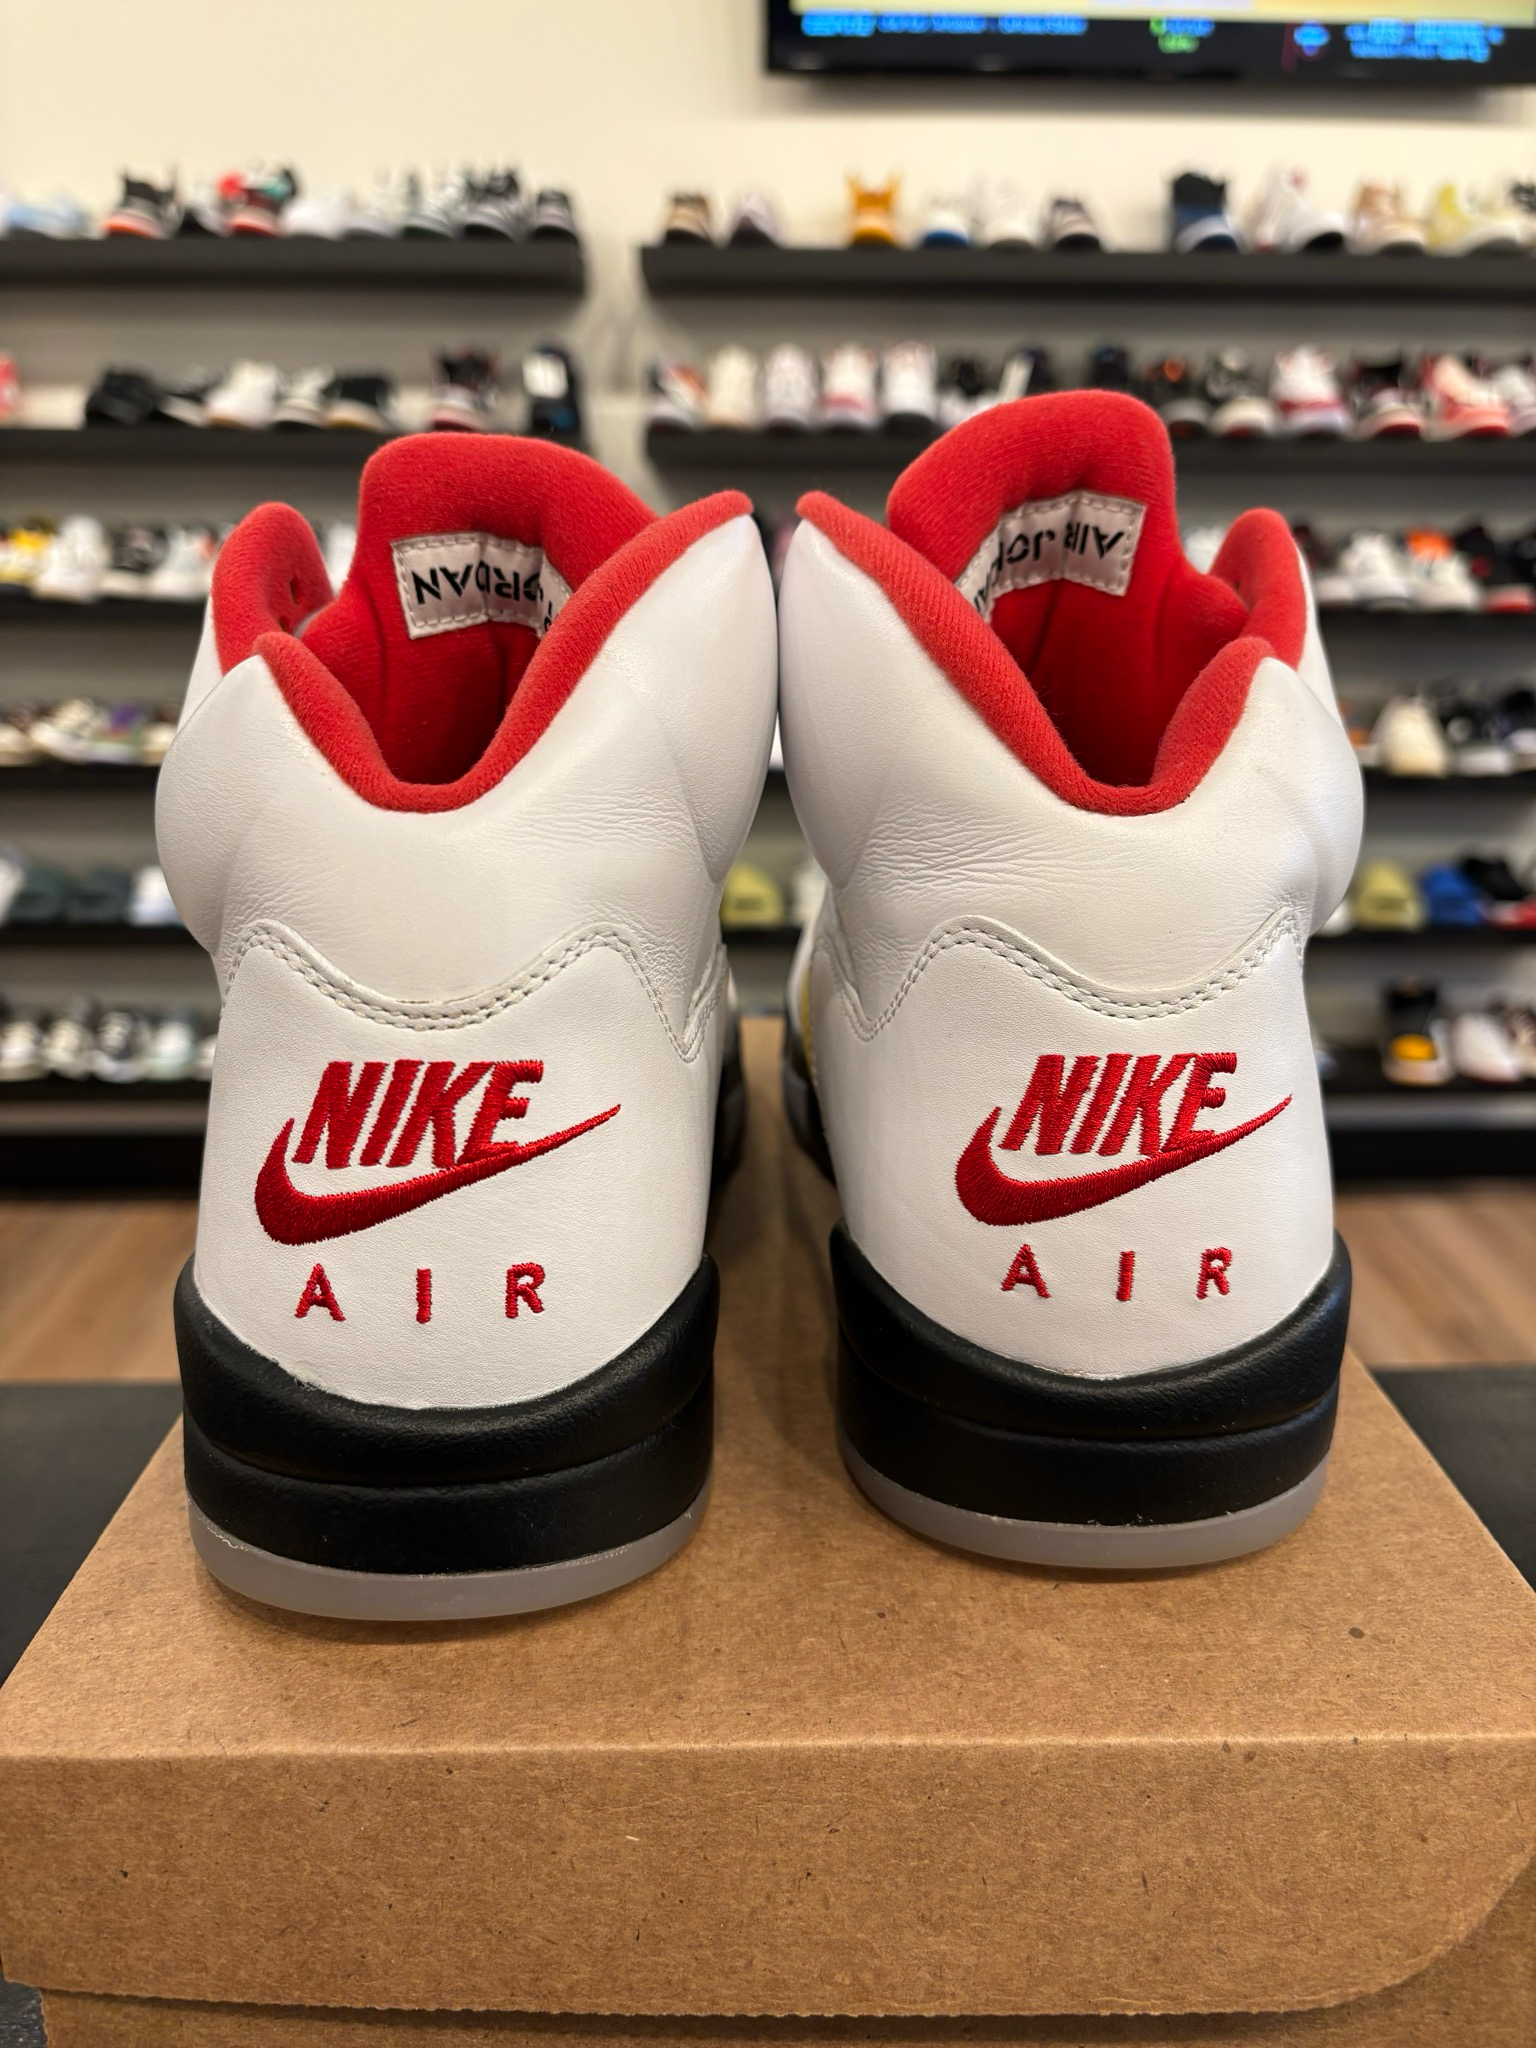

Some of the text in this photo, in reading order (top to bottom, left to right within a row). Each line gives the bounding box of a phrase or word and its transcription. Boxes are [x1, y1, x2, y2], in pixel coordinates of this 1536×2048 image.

[1064, 522, 1125, 559] AIR
[412, 560, 543, 605] ORDAN
[292, 1059, 545, 1169] NIKE
[998, 1052, 1238, 1157] NIKE
[294, 1263, 546, 1324] AIR
[1001, 1243, 1233, 1302] AIR
